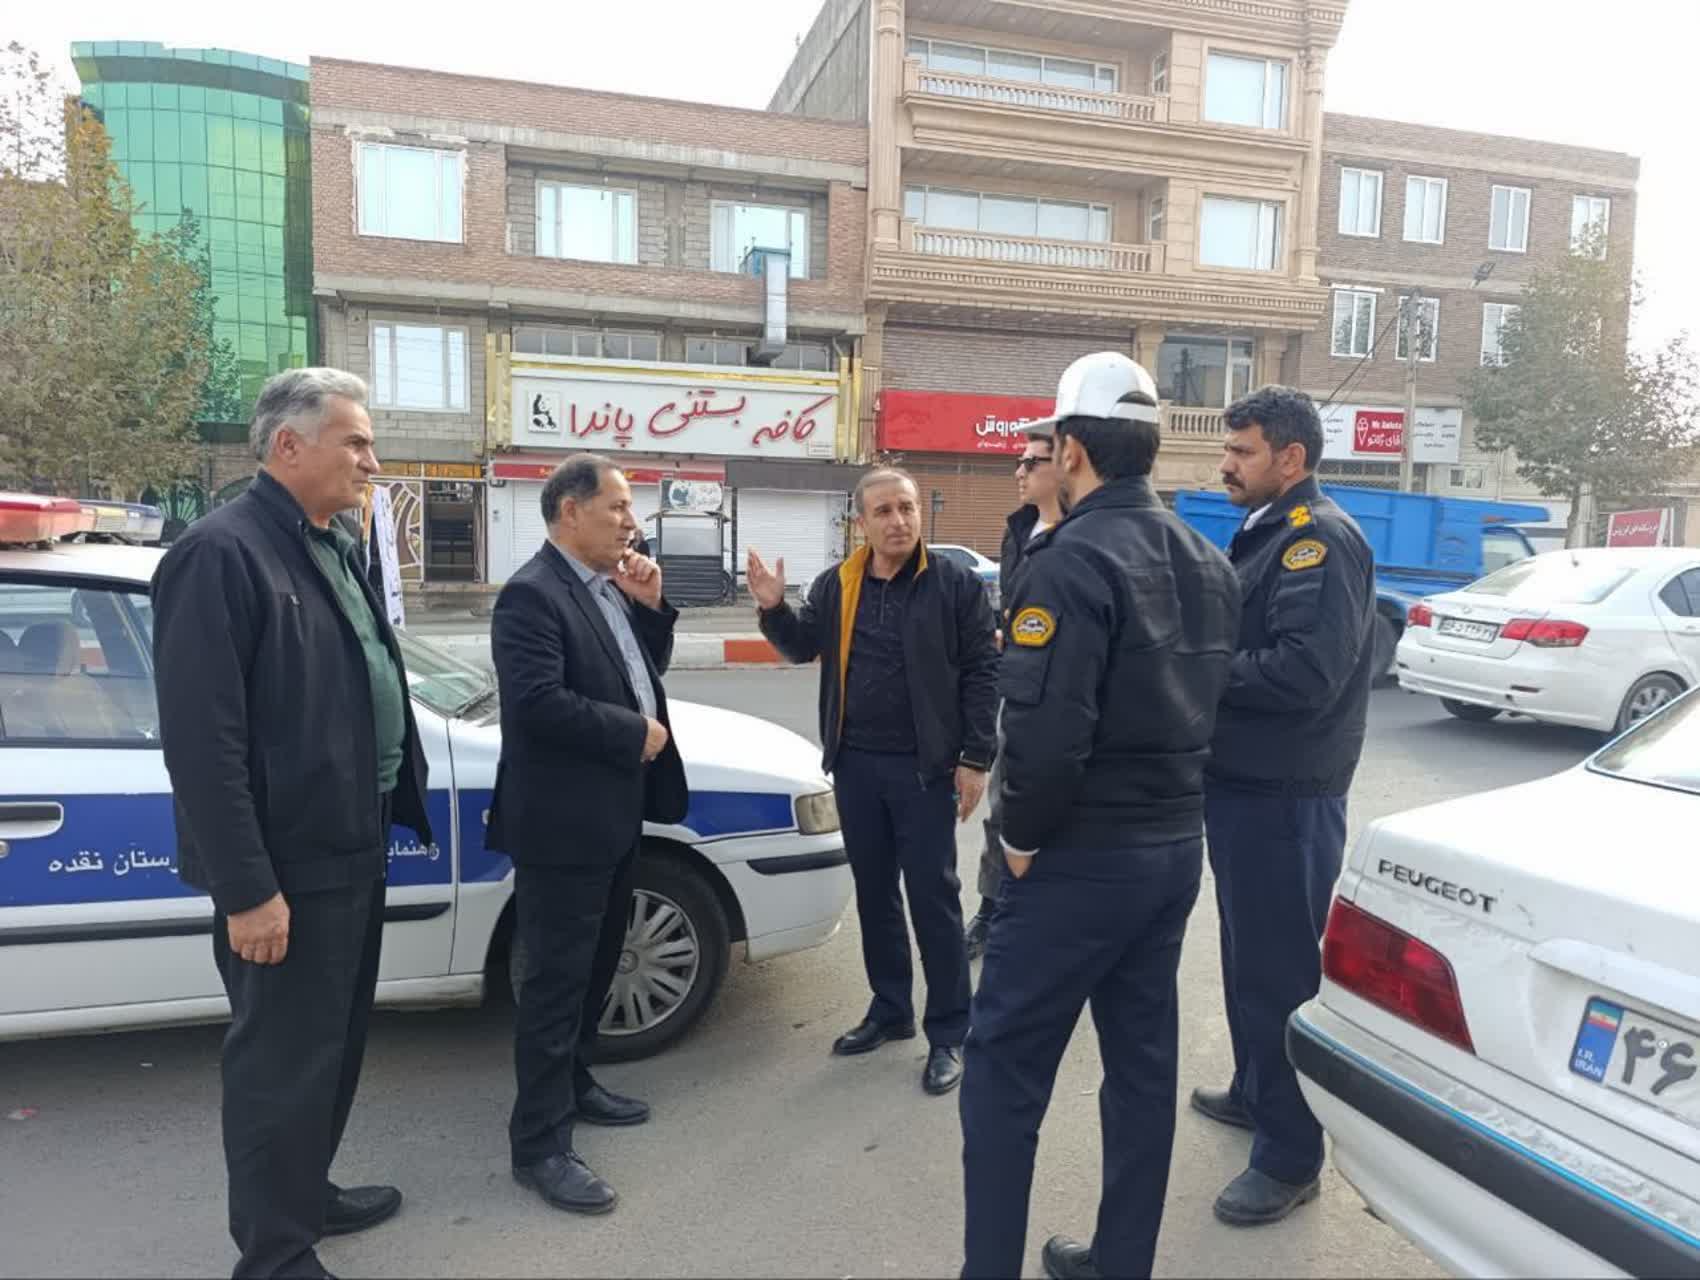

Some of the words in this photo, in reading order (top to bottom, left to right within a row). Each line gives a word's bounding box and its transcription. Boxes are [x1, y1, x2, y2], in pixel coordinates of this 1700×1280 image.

[569, 402, 634, 448] پاندا
[648, 389, 746, 437] بستنی
[751, 394, 833, 445] کافه
[48, 850, 104, 873] نقده
[1378, 859, 1498, 913] PEUGEOT
[1574, 1059, 1603, 1077] IRAN
